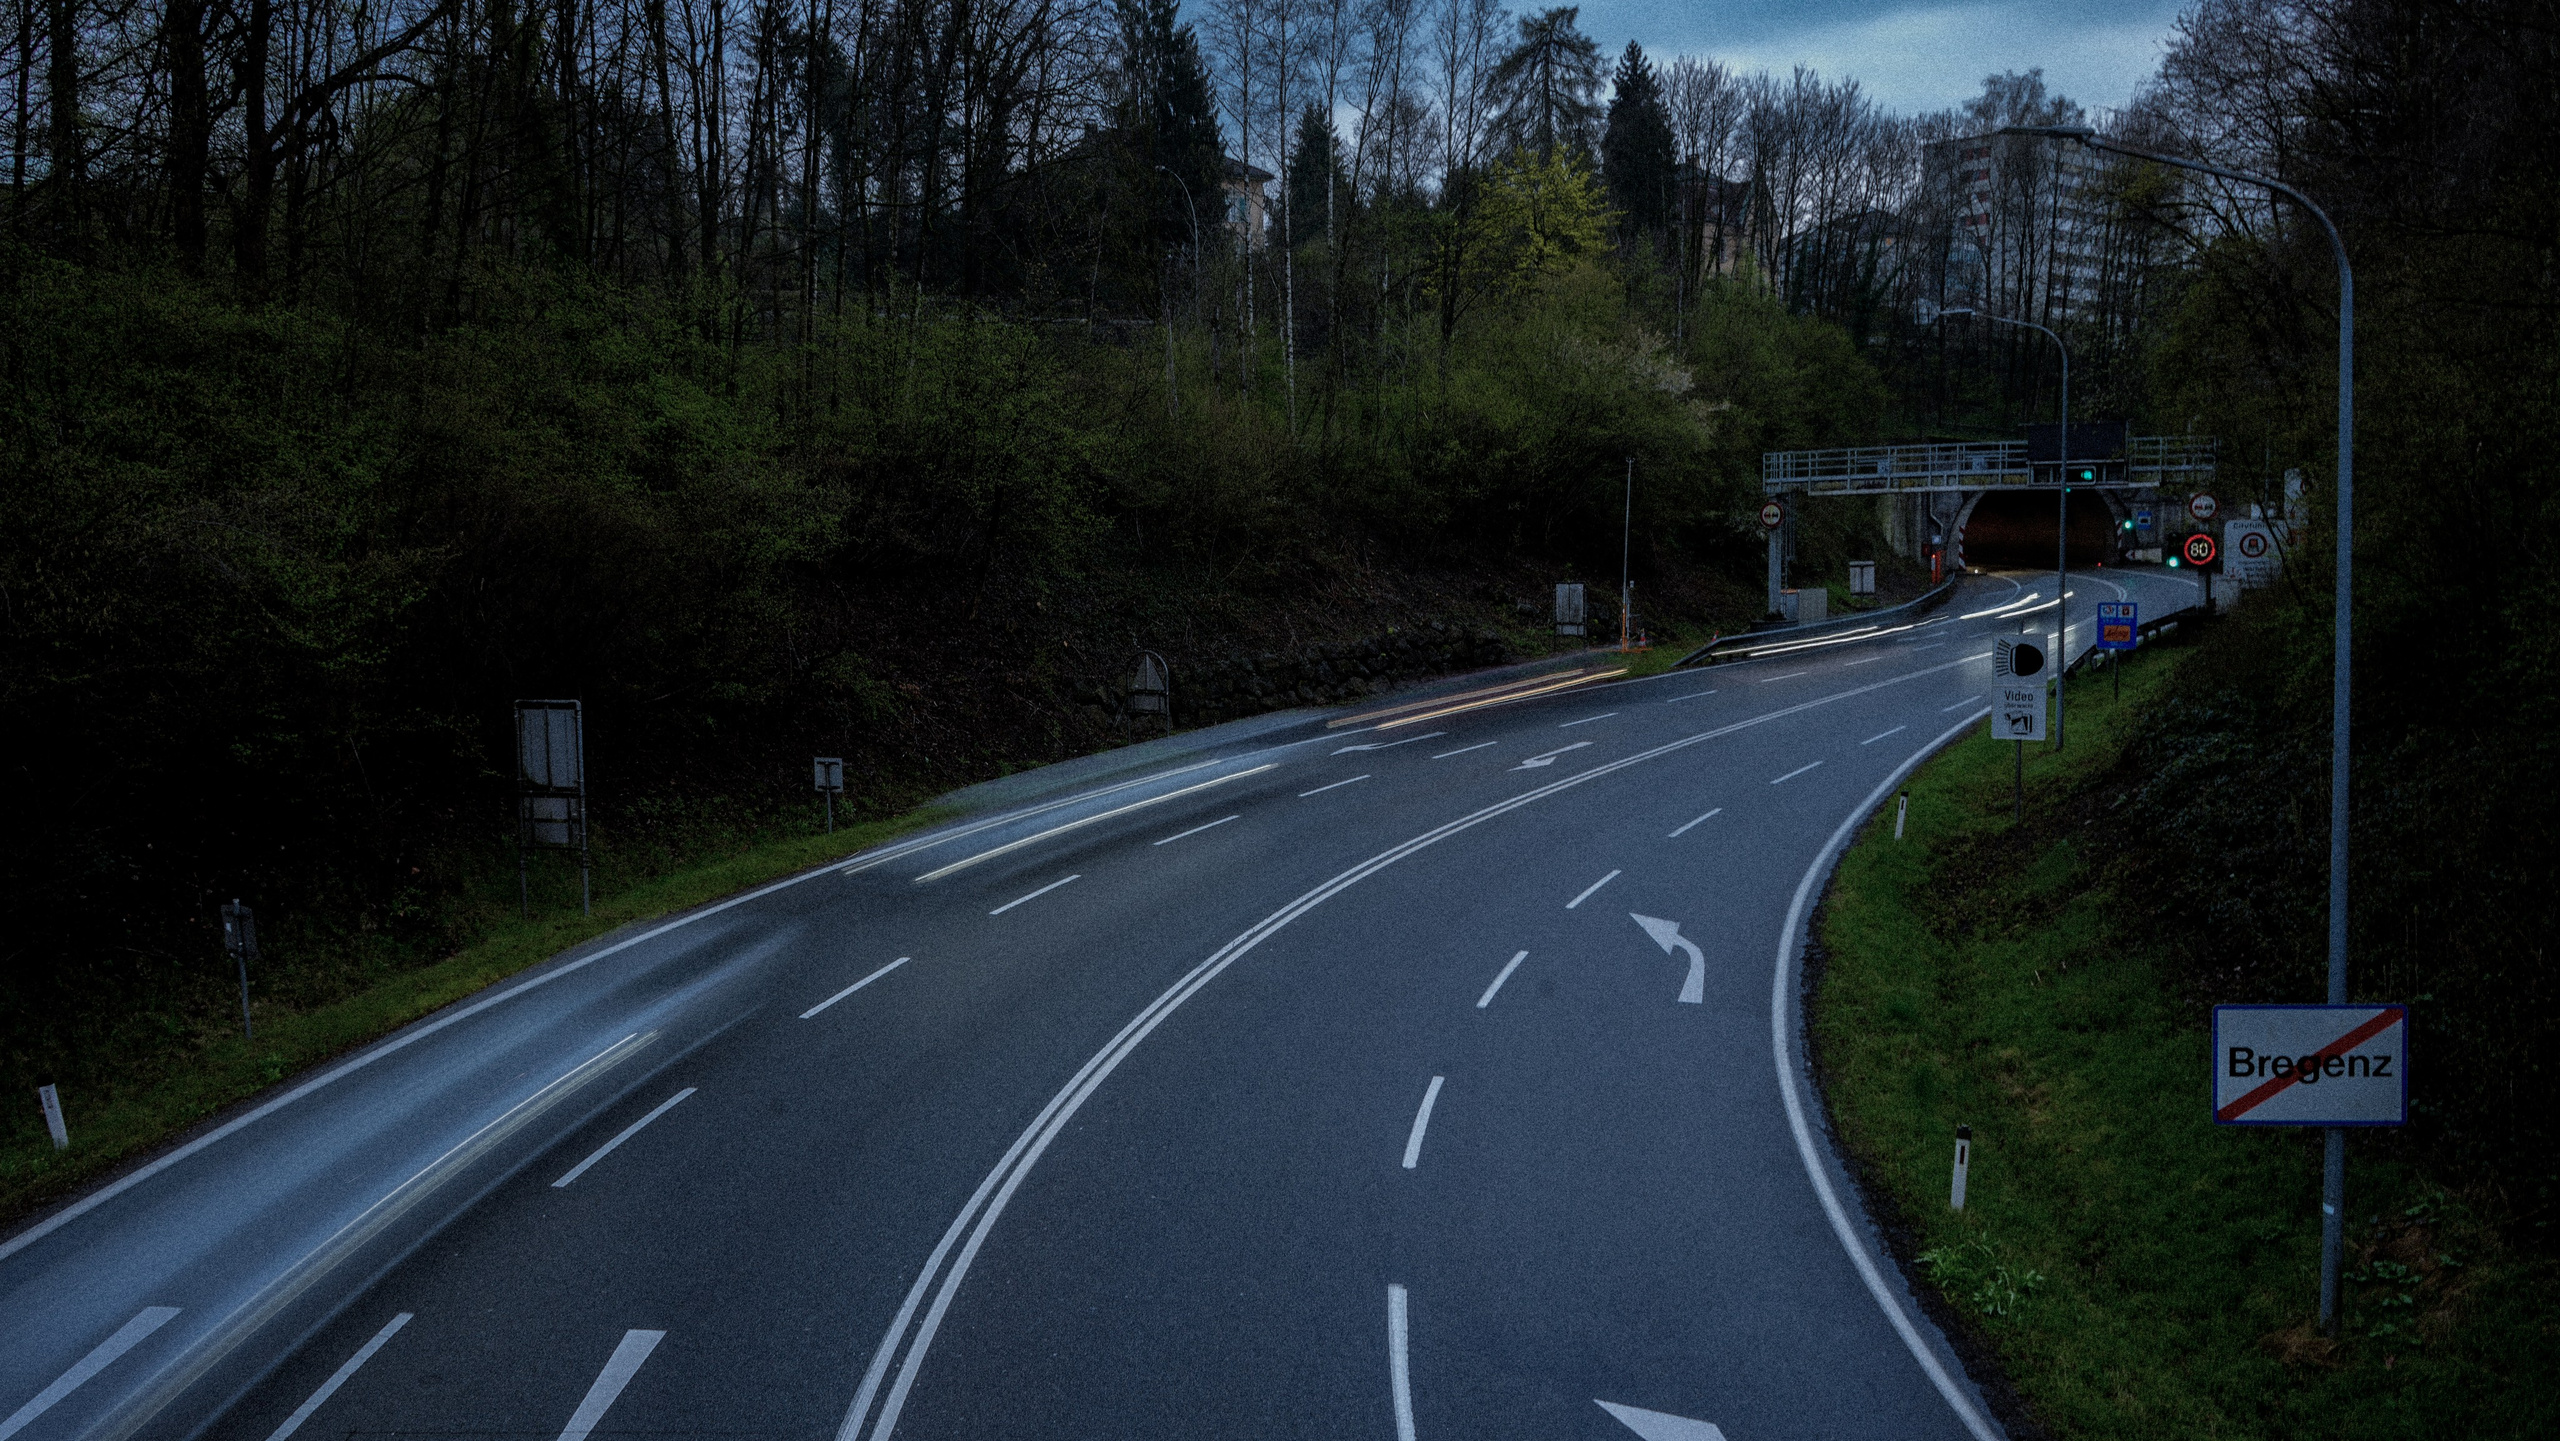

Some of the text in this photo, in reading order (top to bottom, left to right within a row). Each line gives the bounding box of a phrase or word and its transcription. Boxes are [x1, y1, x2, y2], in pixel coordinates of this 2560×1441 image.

[2190, 542, 2209, 557] 80
[2004, 690, 2034, 702] Video
[2229, 1047, 2392, 1084] Bregenz
